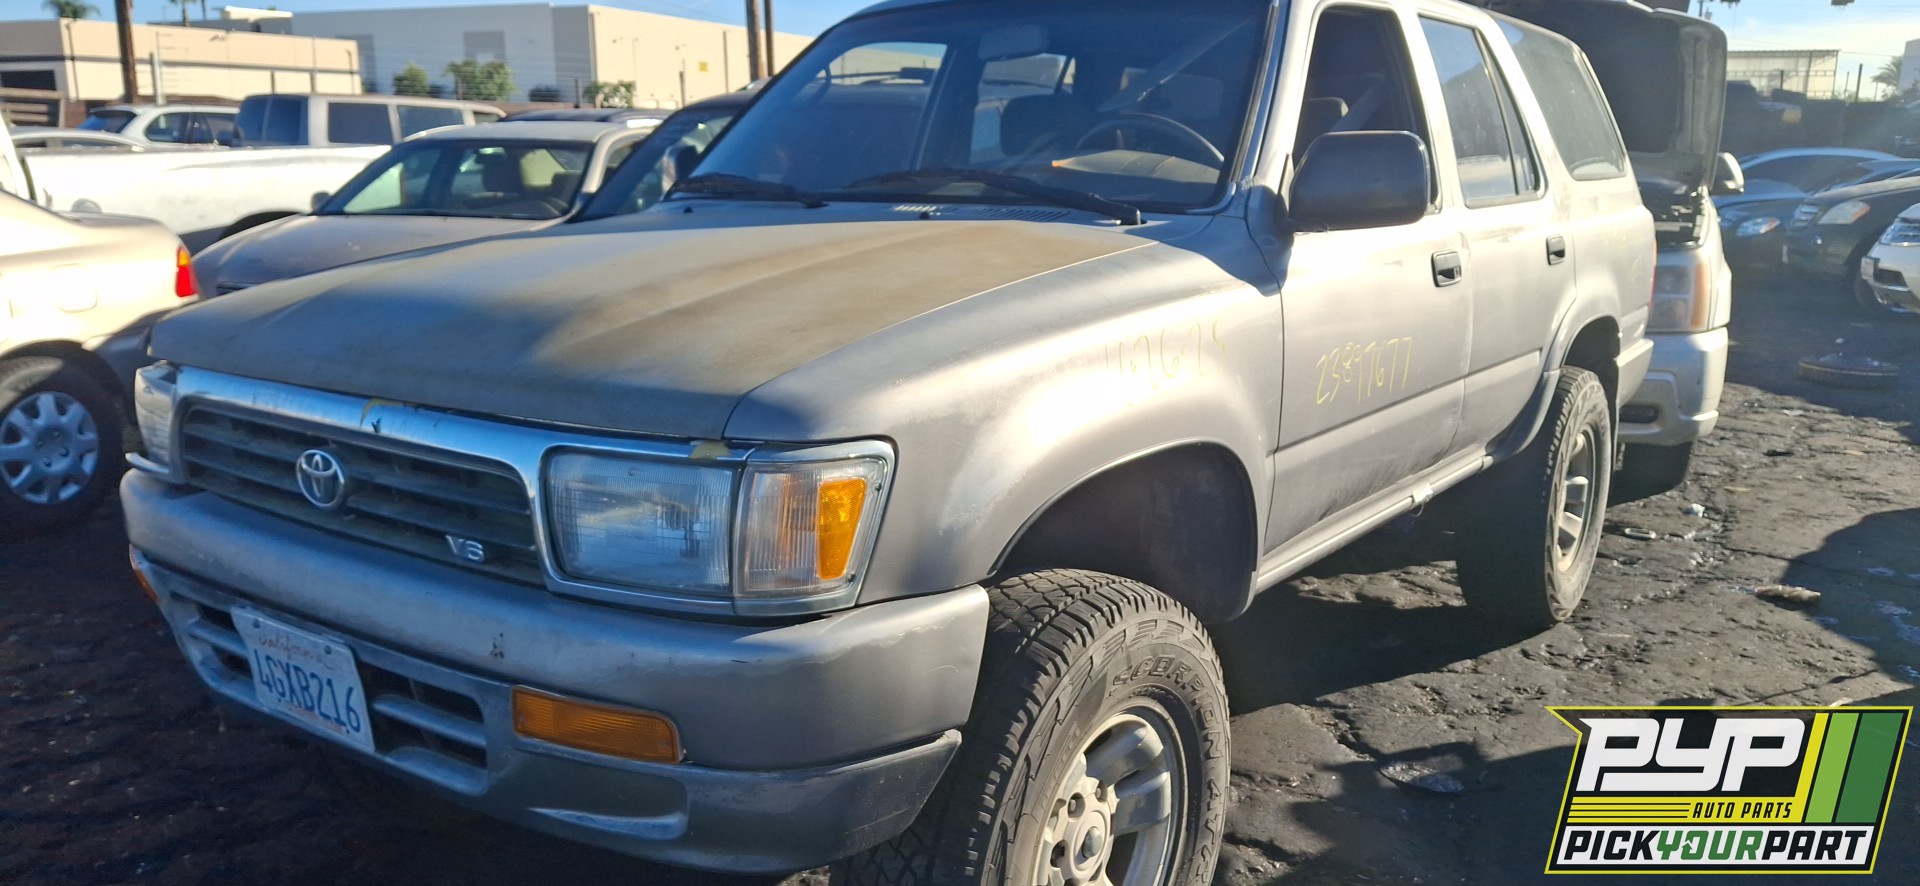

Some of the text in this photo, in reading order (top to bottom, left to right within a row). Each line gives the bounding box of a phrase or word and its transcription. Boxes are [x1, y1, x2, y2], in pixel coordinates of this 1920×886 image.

[1315, 336, 1412, 407] 23897677
[445, 534, 484, 562] V6
[253, 649, 361, 733] 4GXB216
[1112, 654, 1224, 760] SCORPION
